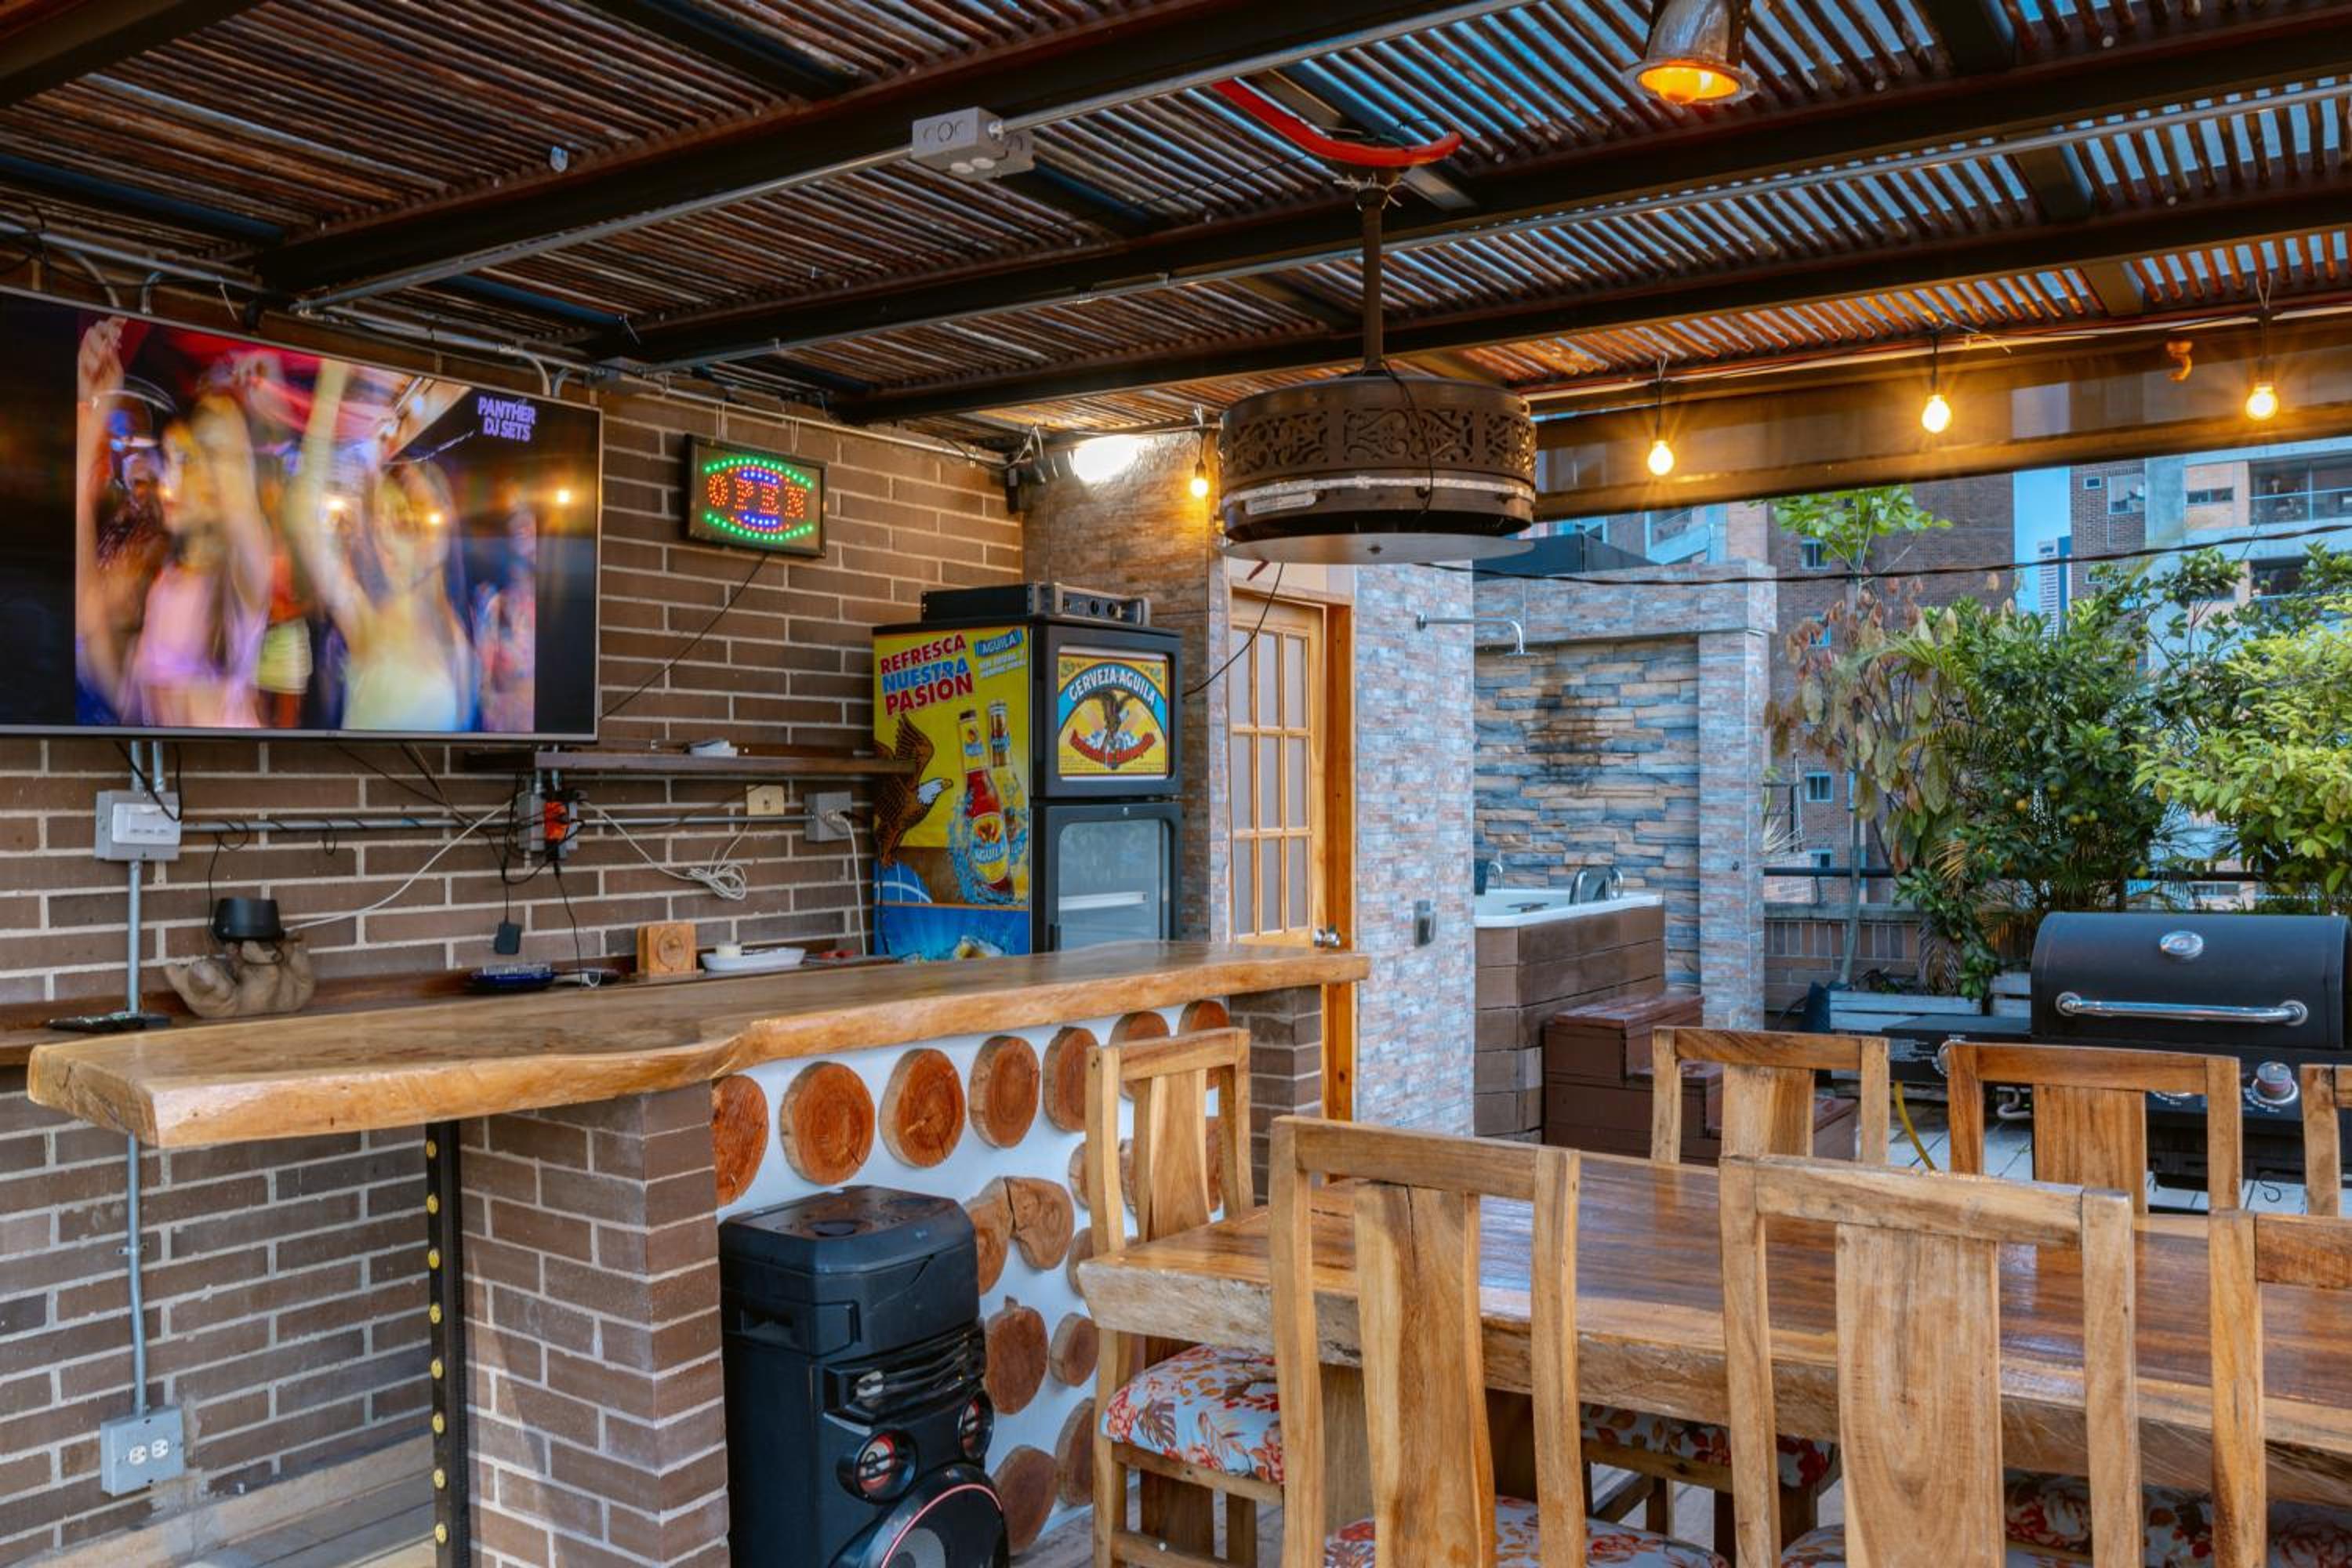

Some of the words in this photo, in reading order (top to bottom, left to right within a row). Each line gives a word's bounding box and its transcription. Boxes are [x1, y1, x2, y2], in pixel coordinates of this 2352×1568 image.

[477, 396, 535, 425] PANTHER
[483, 417, 500, 436] DJ
[500, 421, 532, 442] SETS
[880, 633, 967, 675] REFRESCA
[882, 656, 969, 694] NUESTRA
